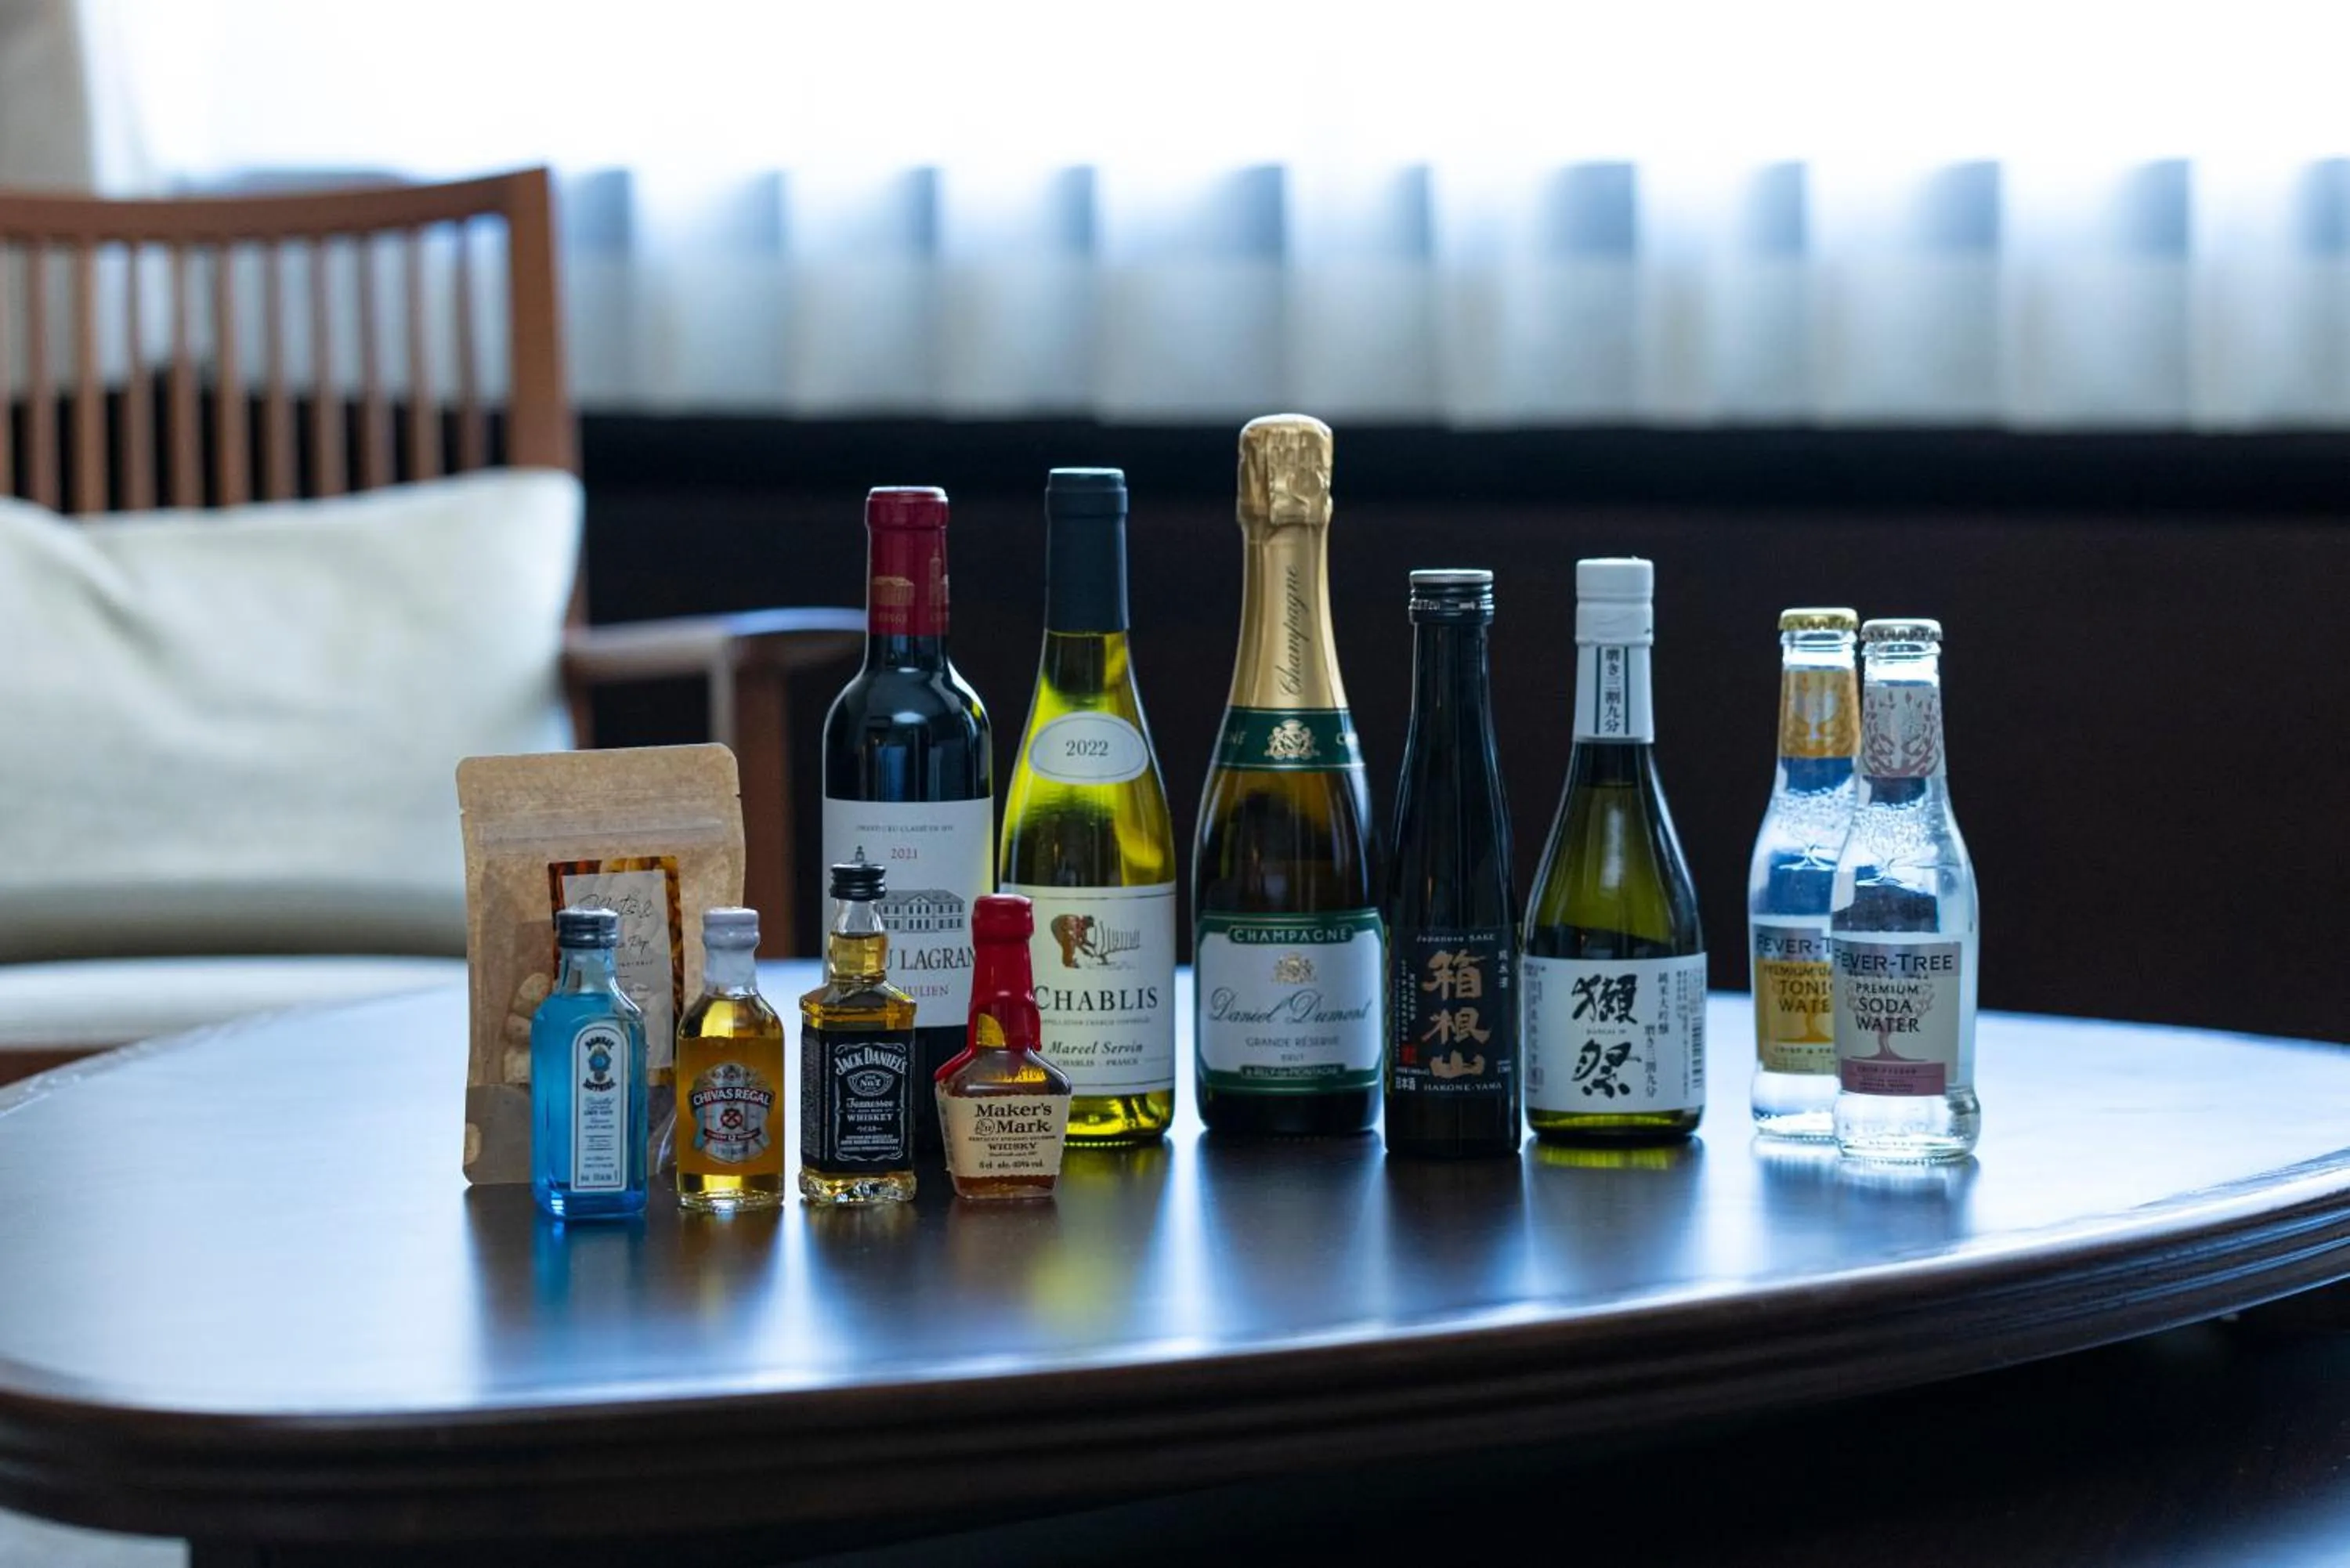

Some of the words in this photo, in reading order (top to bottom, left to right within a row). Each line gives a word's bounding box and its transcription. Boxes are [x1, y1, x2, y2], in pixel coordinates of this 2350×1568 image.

[1275, 565, 1310, 695] Champagne
[1065, 739, 1108, 757] 2022
[891, 848, 917, 859] 2021
[1233, 929, 1349, 941] CHAMPAGNE
[1756, 934, 1831, 954] FEVER-T
[901, 946, 975, 970] LAGRAN
[1835, 948, 1953, 973] FEVER-TREE
[1856, 982, 1918, 995] PREMIUM
[1034, 985, 1158, 1012] CHABLIS
[1779, 999, 1830, 1013] WATE
[1859, 998, 1913, 1014] SODA
[1422, 949, 1492, 1078] 箱根山
[1856, 1016, 1921, 1033] WATER
[1246, 1037, 1292, 1048] GRANDE
[1571, 974, 1642, 1099] 獺祭
[1049, 1040, 1098, 1055] Marcel
[1101, 1039, 1144, 1054] Servin
[834, 1053, 863, 1075] JACK
[1423, 1082, 1502, 1092] HAKONE-YAMA
[693, 1088, 734, 1106] CHIVAS
[735, 1088, 770, 1107] REGAL
[847, 1113, 894, 1122] WHISKEY
[974, 1103, 1052, 1118] Maker's
[996, 1119, 1053, 1134] Mark
[988, 1142, 1038, 1152] WHISKY
